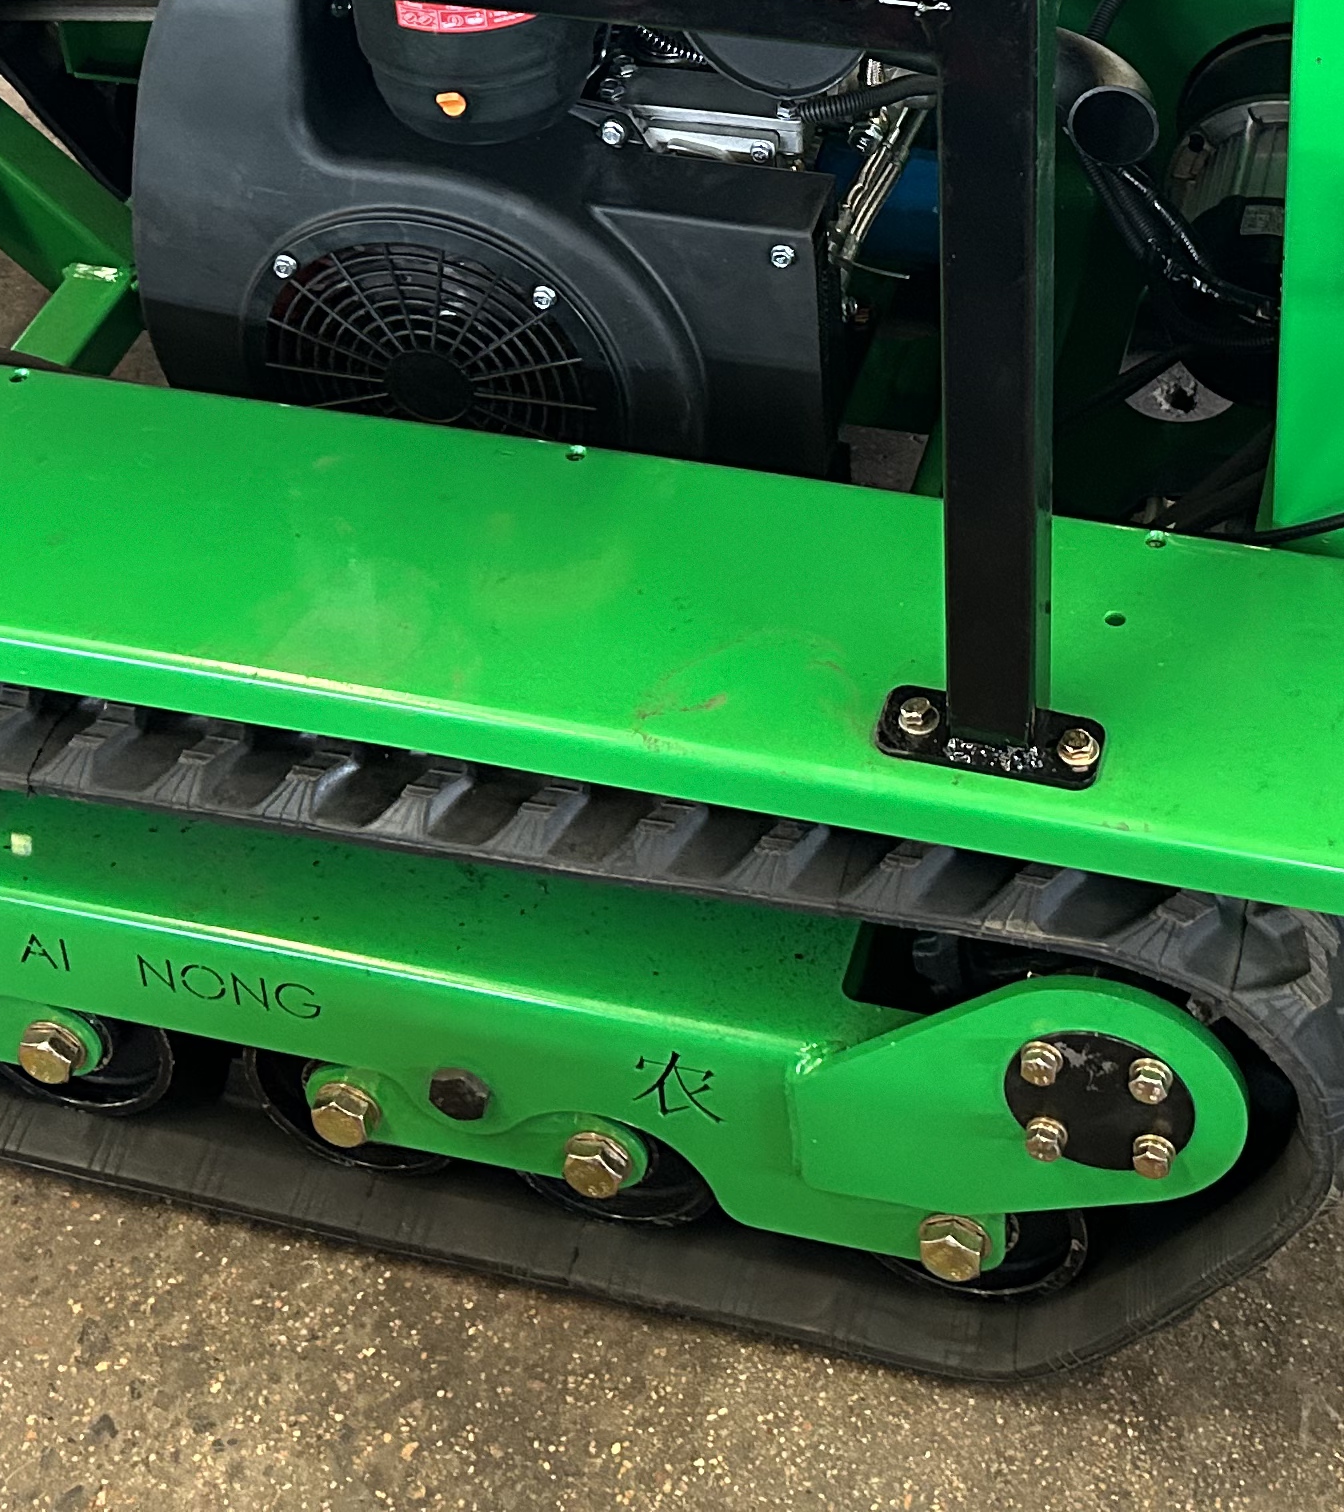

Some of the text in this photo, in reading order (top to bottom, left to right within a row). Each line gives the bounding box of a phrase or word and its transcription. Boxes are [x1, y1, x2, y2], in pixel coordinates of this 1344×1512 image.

[21, 933, 322, 1019] AI NONG
[632, 1050, 726, 1123] 农
